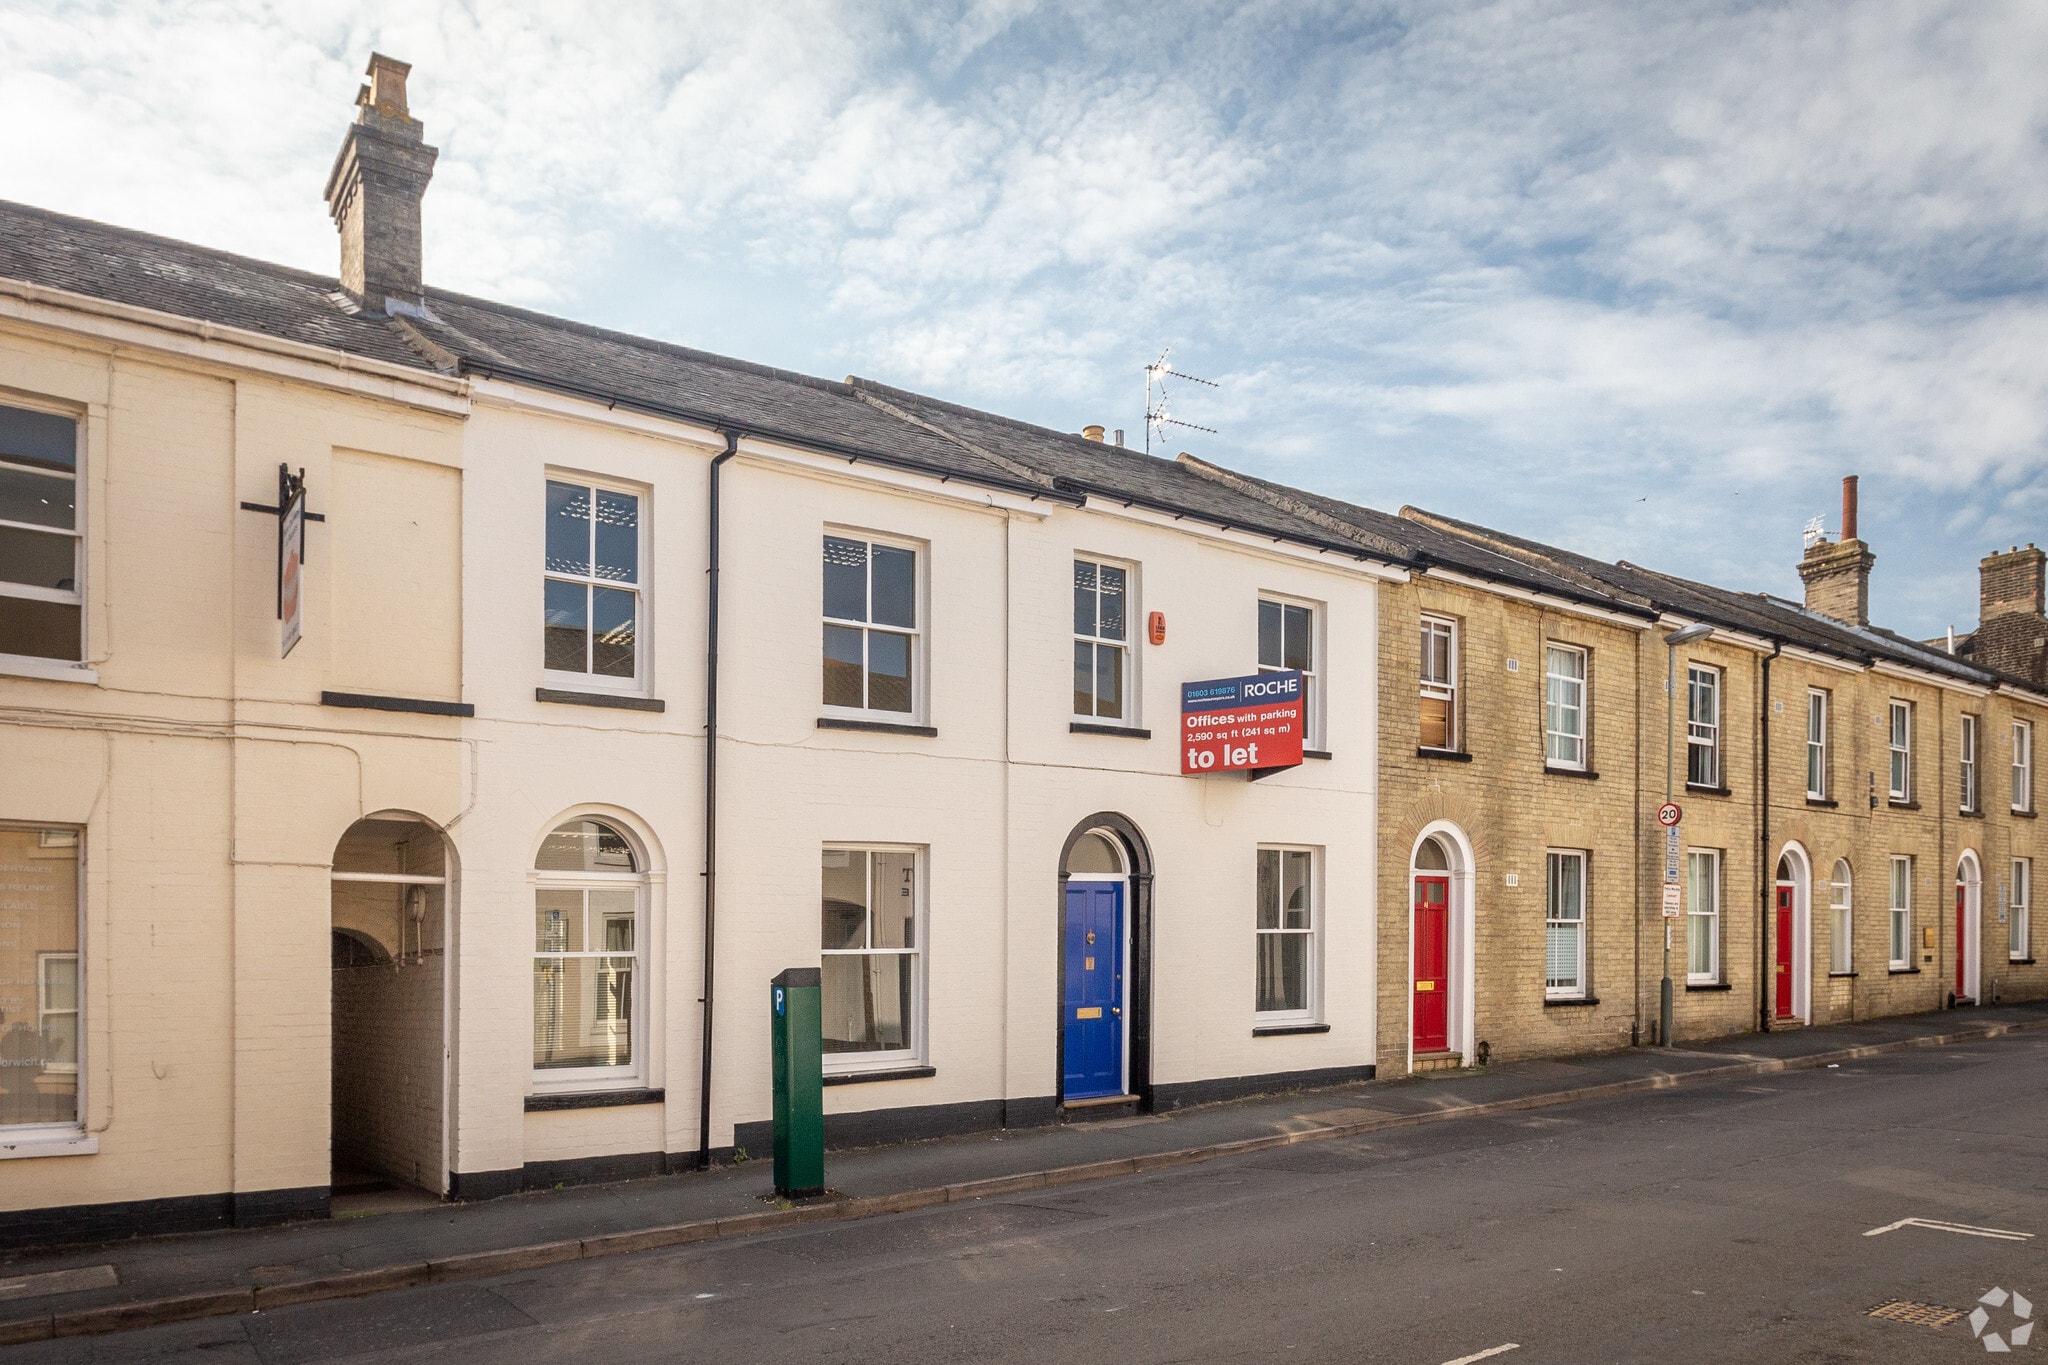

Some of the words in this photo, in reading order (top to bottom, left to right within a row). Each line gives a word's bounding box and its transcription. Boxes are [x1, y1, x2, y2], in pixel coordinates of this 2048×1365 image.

[1187, 688, 1209, 698] 01603
[1209, 686, 1236, 696] 619876
[1244, 679, 1298, 698] ROCHE
[1186, 714, 1236, 728] Offices
[1237, 713, 1257, 723] with
[1260, 709, 1297, 722] parking
[1187, 731, 1213, 743] 2,590
[1216, 732, 1228, 740] sq
[1231, 729, 1239, 738] ft
[1241, 727, 1261, 738] (241
[1263, 726, 1275, 736] sq
[1278, 723, 1291, 734] m)
[1187, 747, 1215, 769] to
[1223, 742, 1258, 767] let
[1661, 809, 1677, 820] 20
[776, 989, 783, 1011] P
